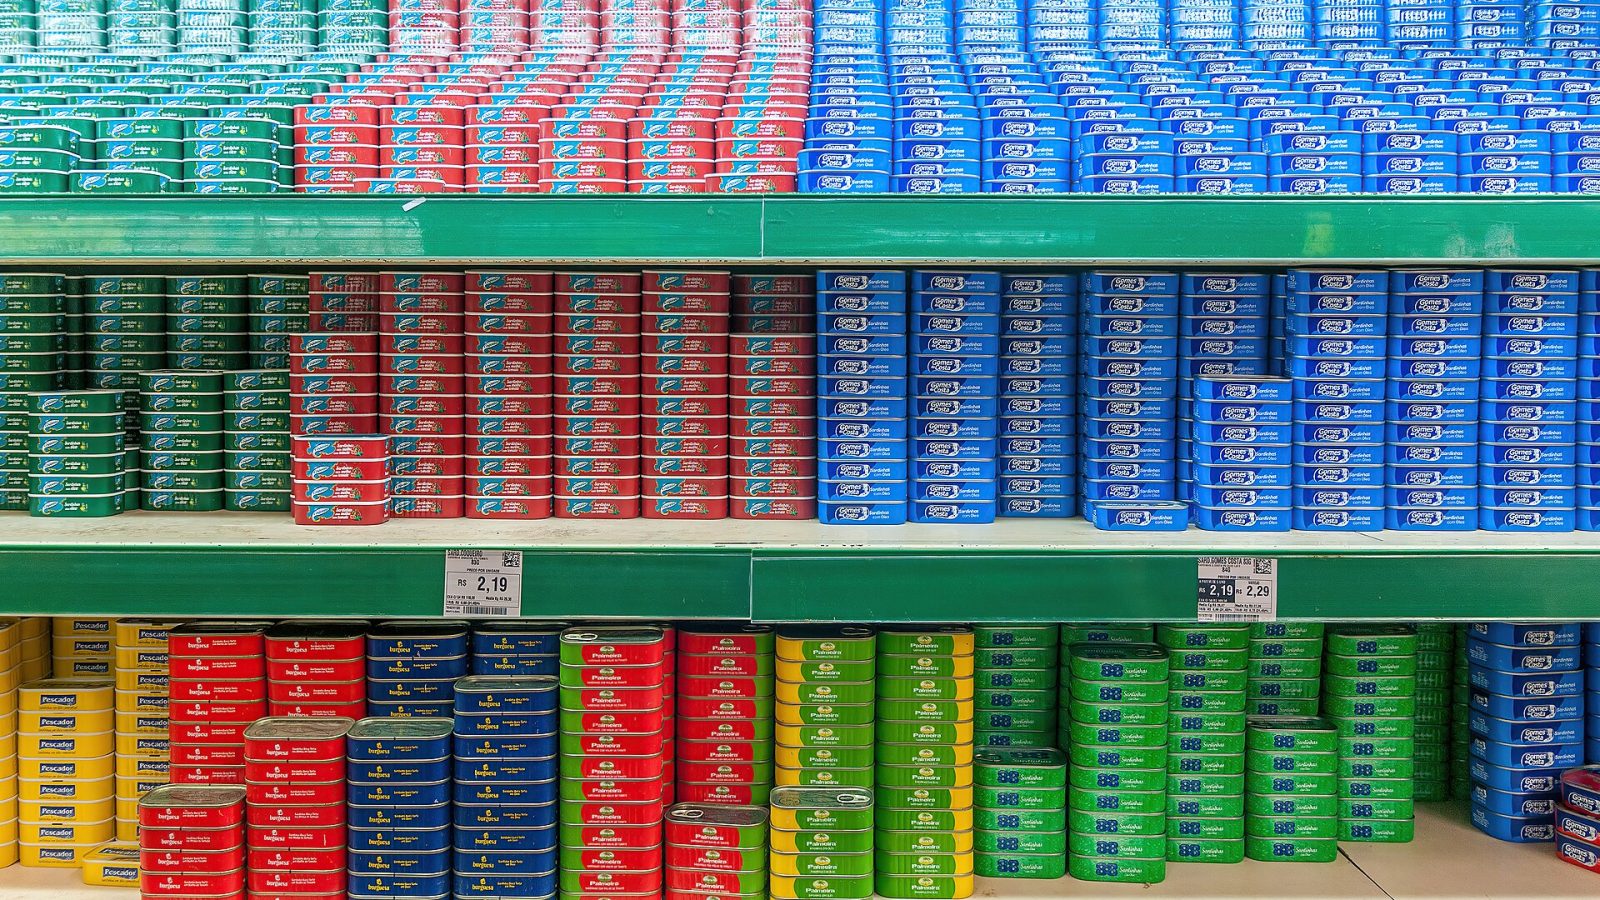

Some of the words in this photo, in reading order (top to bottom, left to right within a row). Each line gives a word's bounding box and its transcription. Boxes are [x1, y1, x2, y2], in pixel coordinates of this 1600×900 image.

[478, 576, 507, 593] 2,19
[1210, 585, 1233, 597] 2,19
[1246, 586, 1269, 598] 2,29
[1572, 794, 1594, 806] Gomes
[1577, 802, 1592, 810] Costa
[1566, 820, 1588, 832] Gomes
[1569, 828, 1586, 838] Costa
[1566, 844, 1588, 857] Gomes
[1568, 852, 1586, 863] Costa
